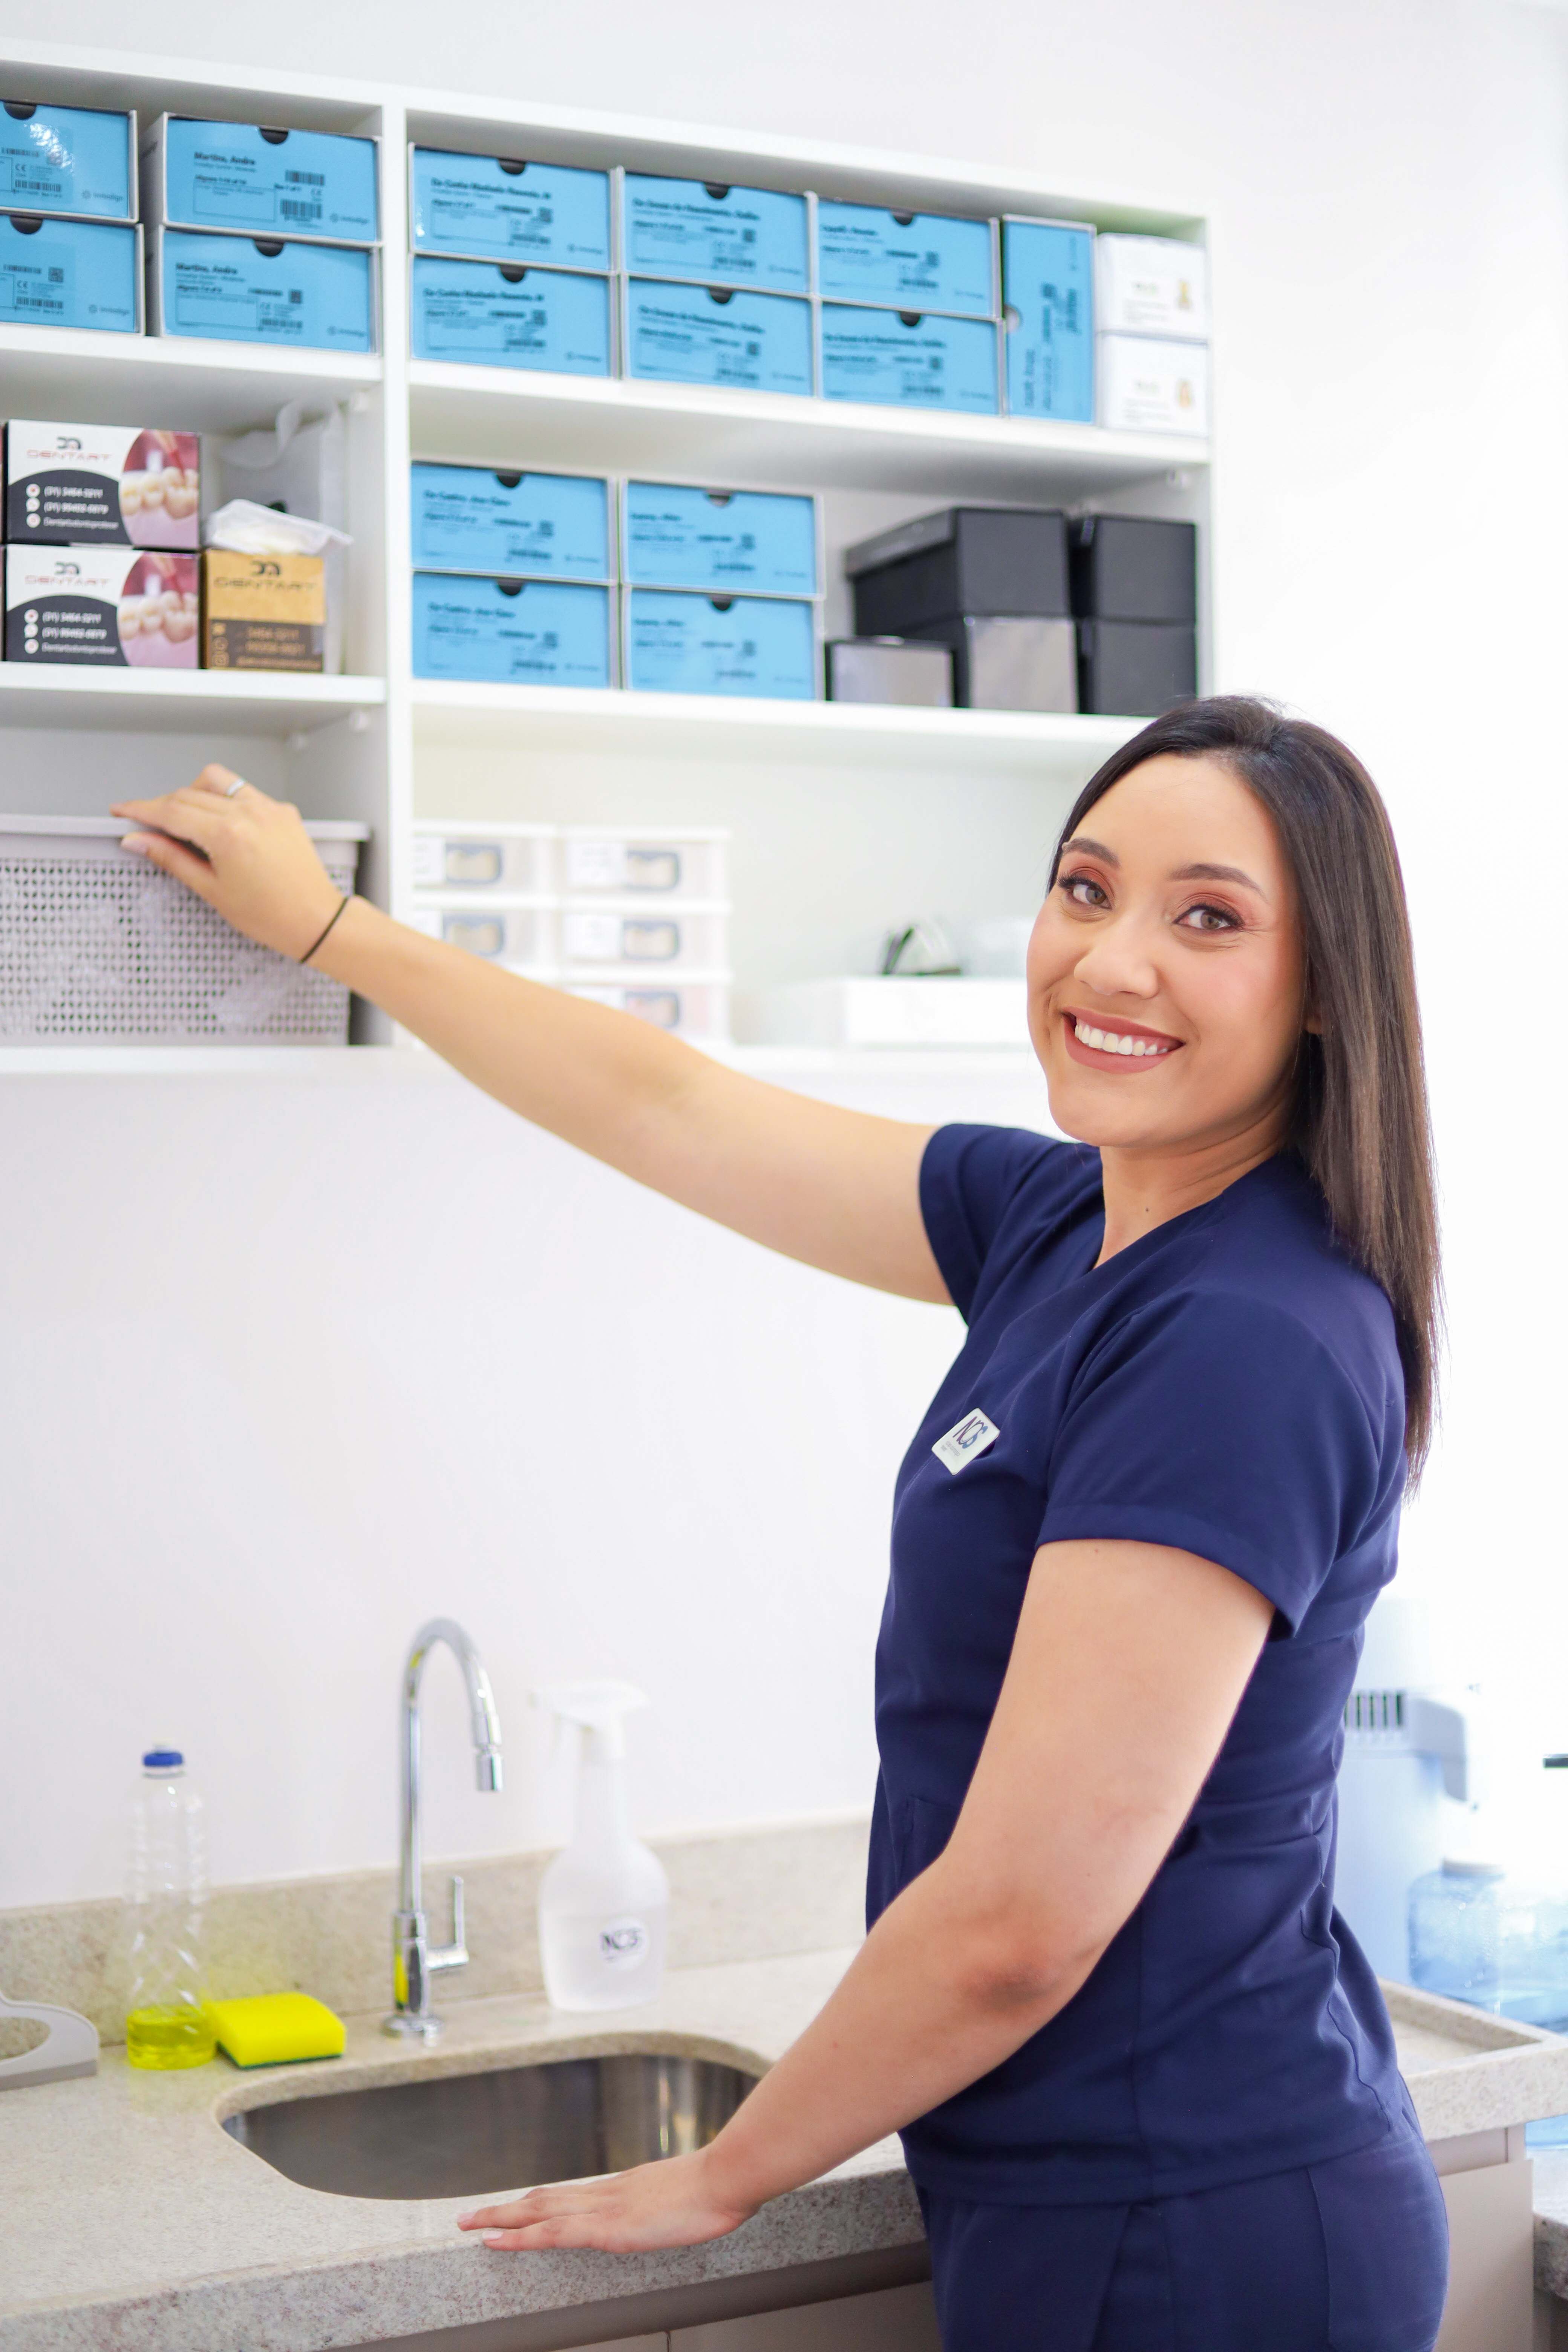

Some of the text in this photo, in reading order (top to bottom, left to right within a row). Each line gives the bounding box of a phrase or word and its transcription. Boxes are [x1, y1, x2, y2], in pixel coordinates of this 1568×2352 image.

[26, 449, 111, 461] DENTART
[24, 575, 110, 587] DENTART
[213, 576, 317, 590] DENTART
